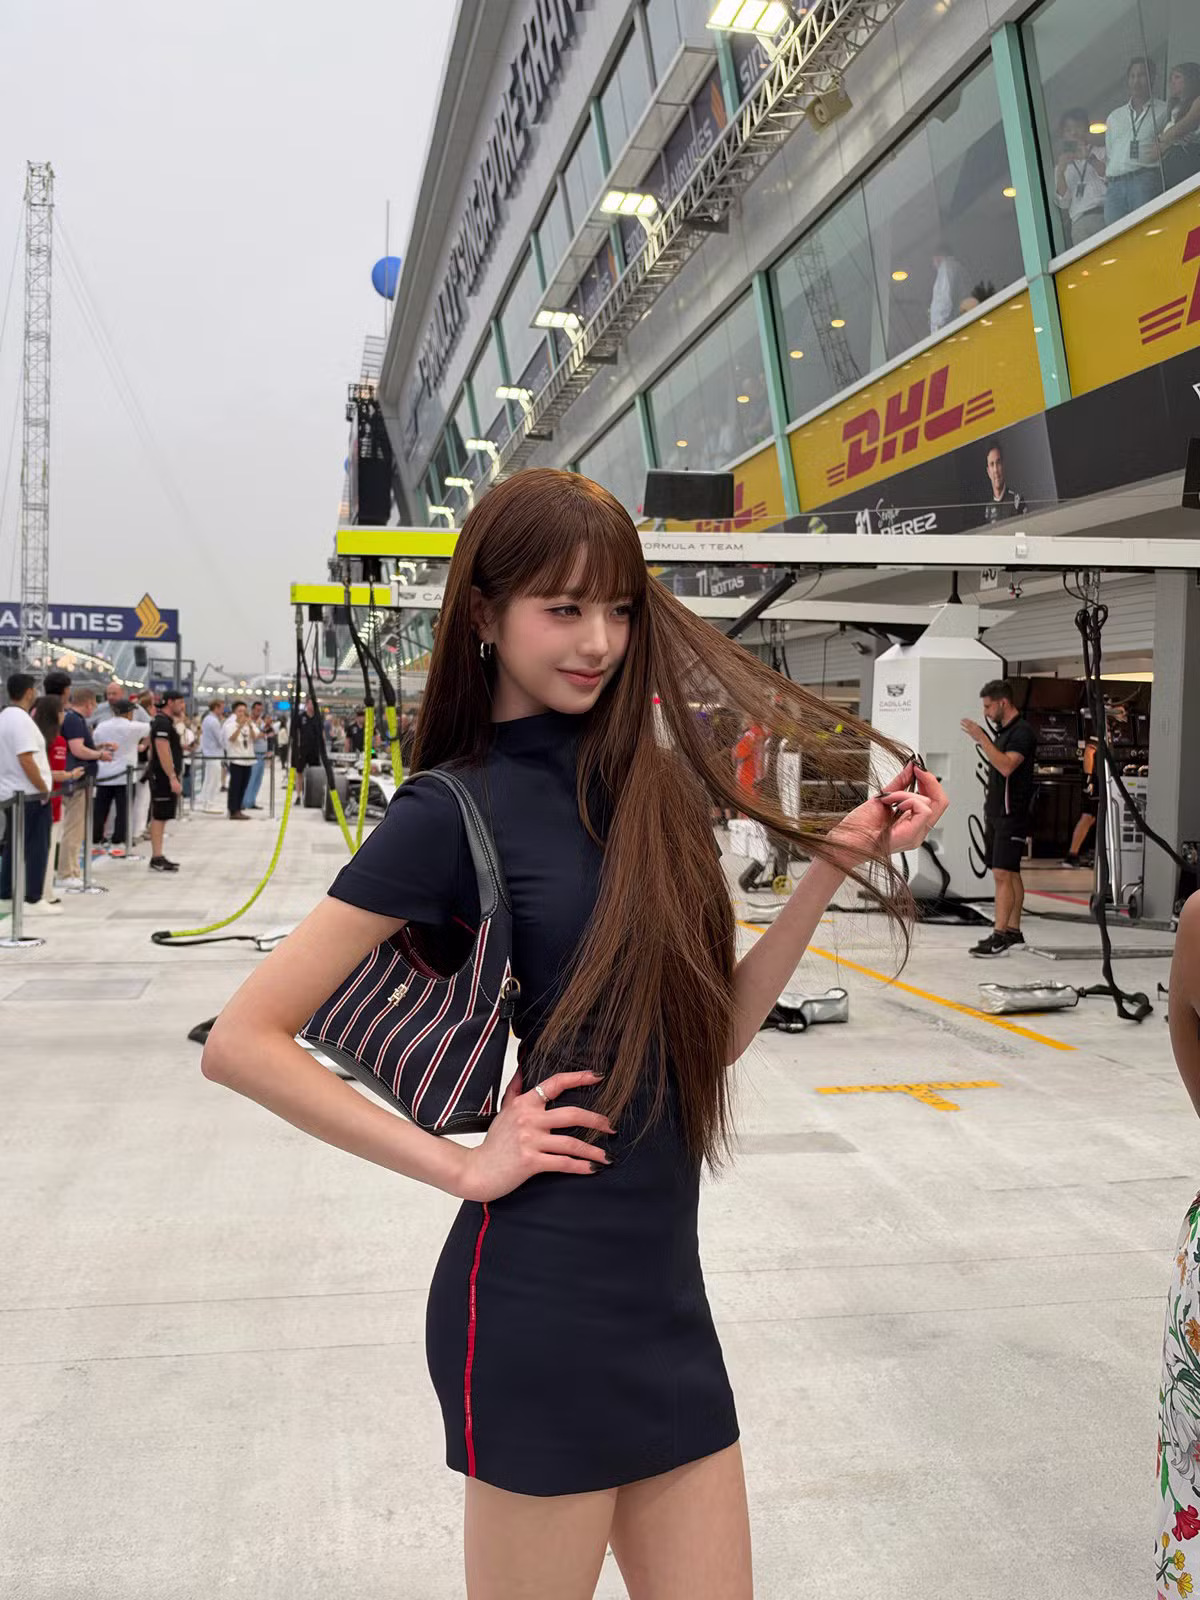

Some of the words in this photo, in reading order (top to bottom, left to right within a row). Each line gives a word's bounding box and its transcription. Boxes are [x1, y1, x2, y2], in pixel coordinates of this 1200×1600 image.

[455, 63, 529, 298] SINGAPORE
[842, 365, 965, 480] DHL
[880, 513, 938, 535] PEREZ
[643, 542, 696, 551] ORMULA
[709, 543, 744, 551] TEAM
[711, 575, 745, 597] BOTTAS
[0, 609, 125, 633] ARLINES
